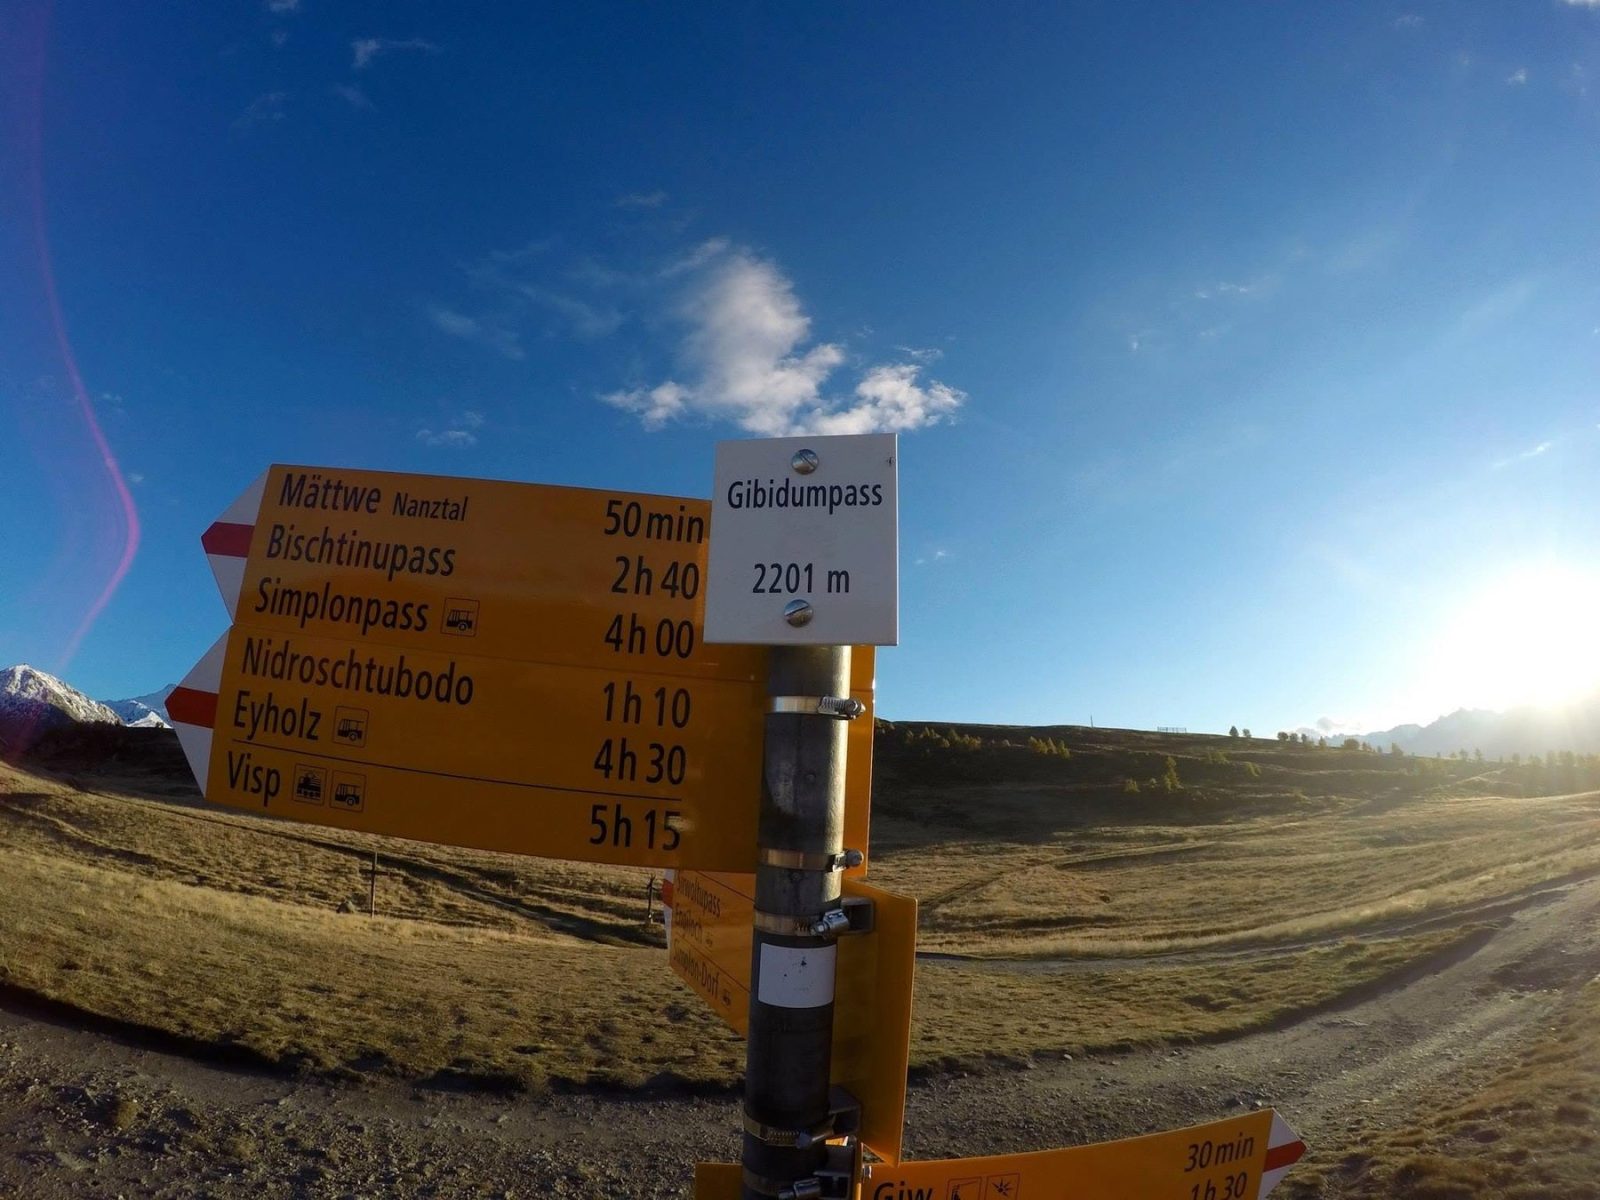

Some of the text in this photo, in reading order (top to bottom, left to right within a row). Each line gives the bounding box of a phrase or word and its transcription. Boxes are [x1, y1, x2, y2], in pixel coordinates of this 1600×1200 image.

[278, 473, 381, 514] Mättwe
[392, 492, 469, 521] Nanztal
[727, 478, 882, 515] Gibidumpass
[266, 524, 456, 581] Bischtinupass
[752, 563, 850, 594] 2201 m
[255, 576, 429, 635] Simplonpass
[241, 637, 473, 705] Nidroschtubodo
[233, 690, 322, 740] Eyholz
[227, 750, 281, 807] Visp
[873, 1181, 933, 1200] Giw
